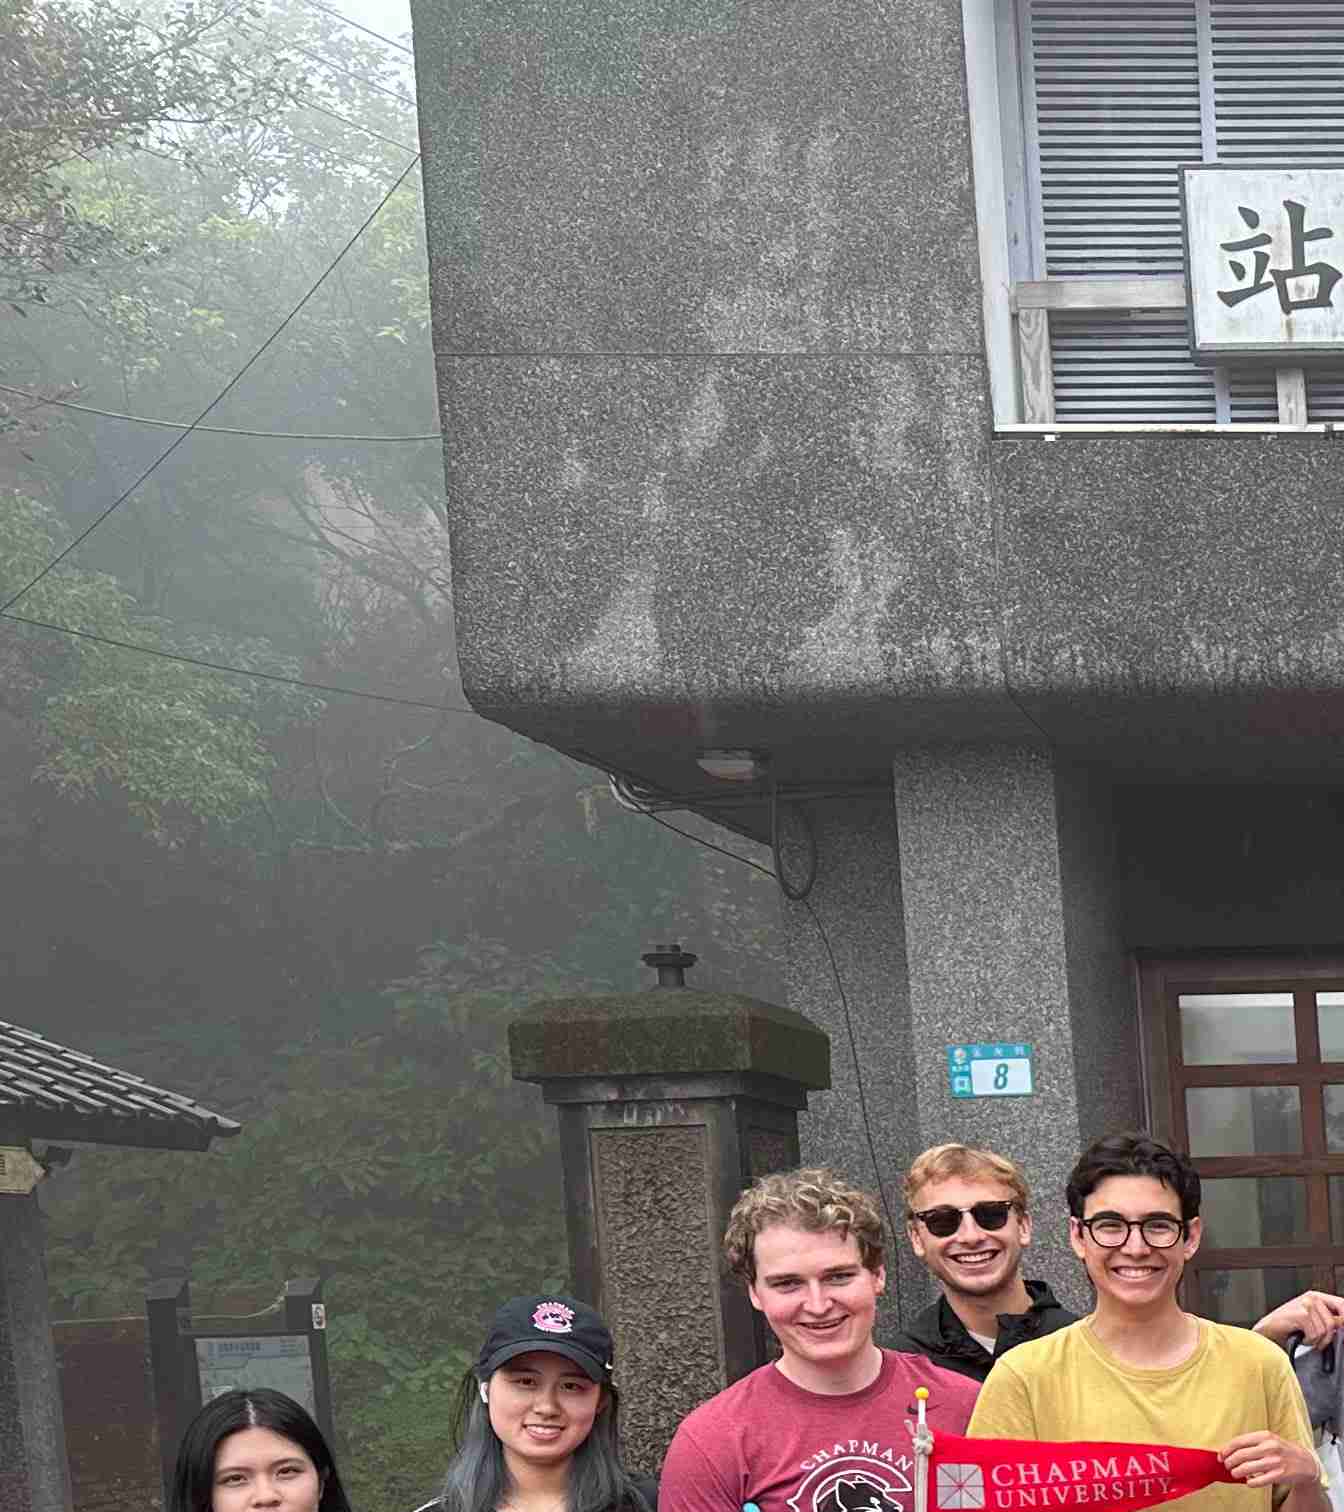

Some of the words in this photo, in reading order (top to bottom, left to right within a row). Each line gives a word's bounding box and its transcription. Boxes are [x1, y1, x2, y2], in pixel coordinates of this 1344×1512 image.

[993, 1062, 1009, 1090] 8
[800, 1439, 914, 1472] CHAPMAN
[991, 1451, 1171, 1487] CHAPMAN
